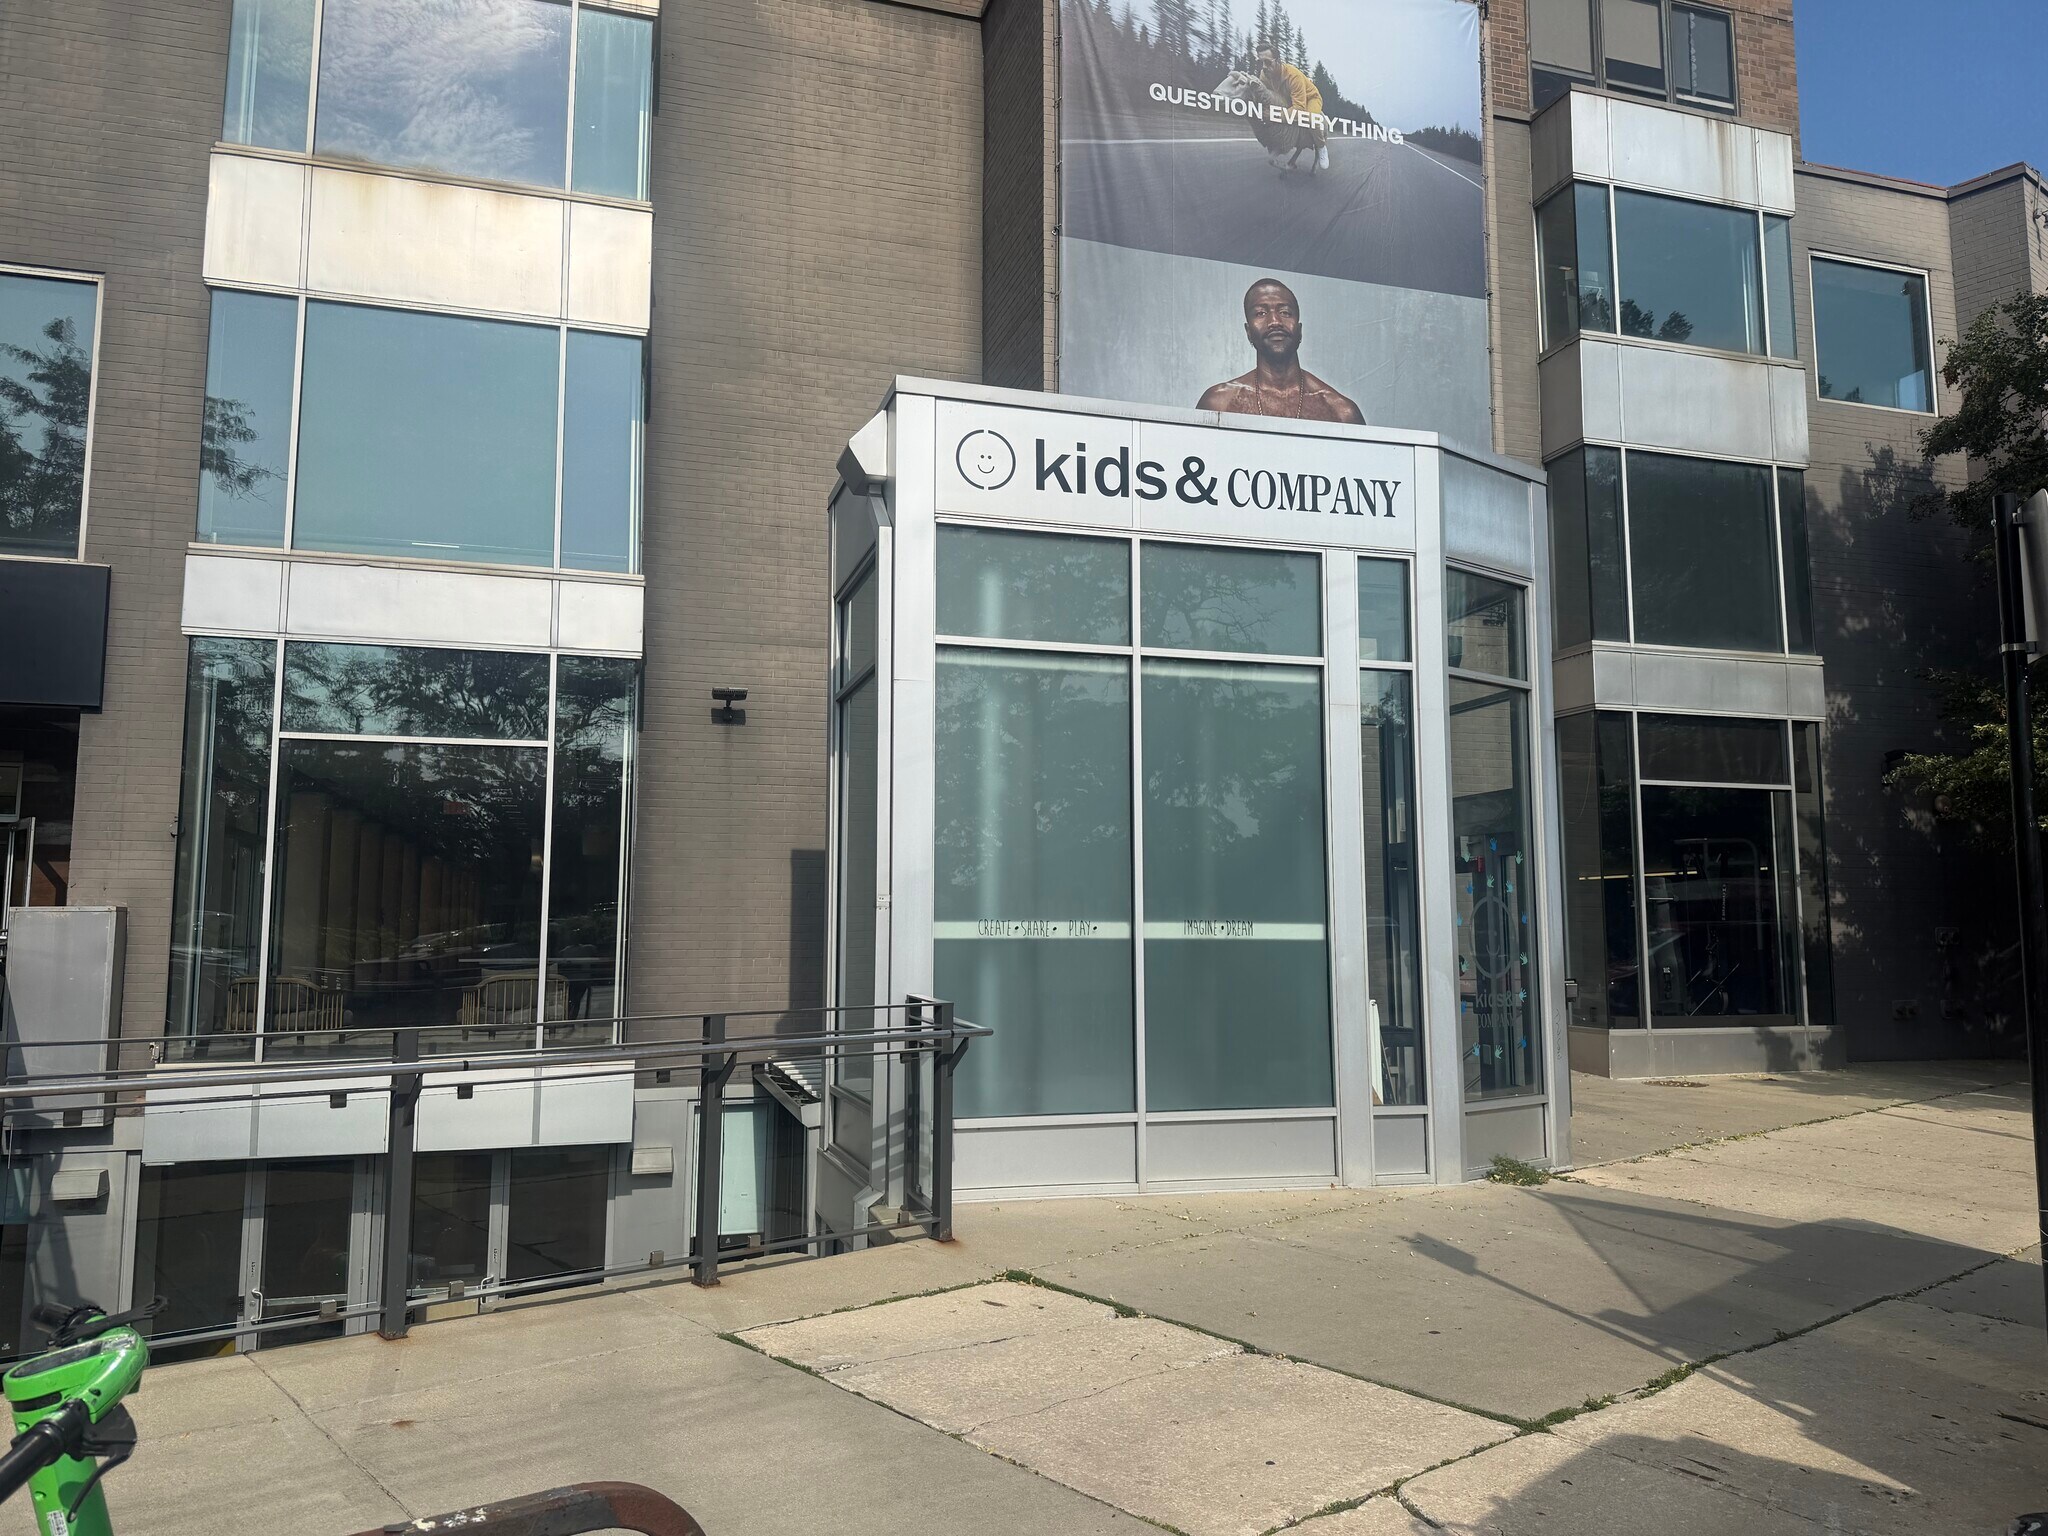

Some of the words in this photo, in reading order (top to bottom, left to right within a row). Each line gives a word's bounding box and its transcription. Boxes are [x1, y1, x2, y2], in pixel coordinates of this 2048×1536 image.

[1149, 82, 1263, 120] QUESTION
[1269, 104, 1404, 145] EVERYTHING
[1226, 467, 1402, 518] COMPANY
[978, 918, 1012, 937] CREATE
[1020, 920, 1051, 937] SHARE
[1068, 919, 1092, 937] PLAY
[1183, 919, 1218, 936] IMAGINE
[1225, 920, 1254, 937] DREAM
